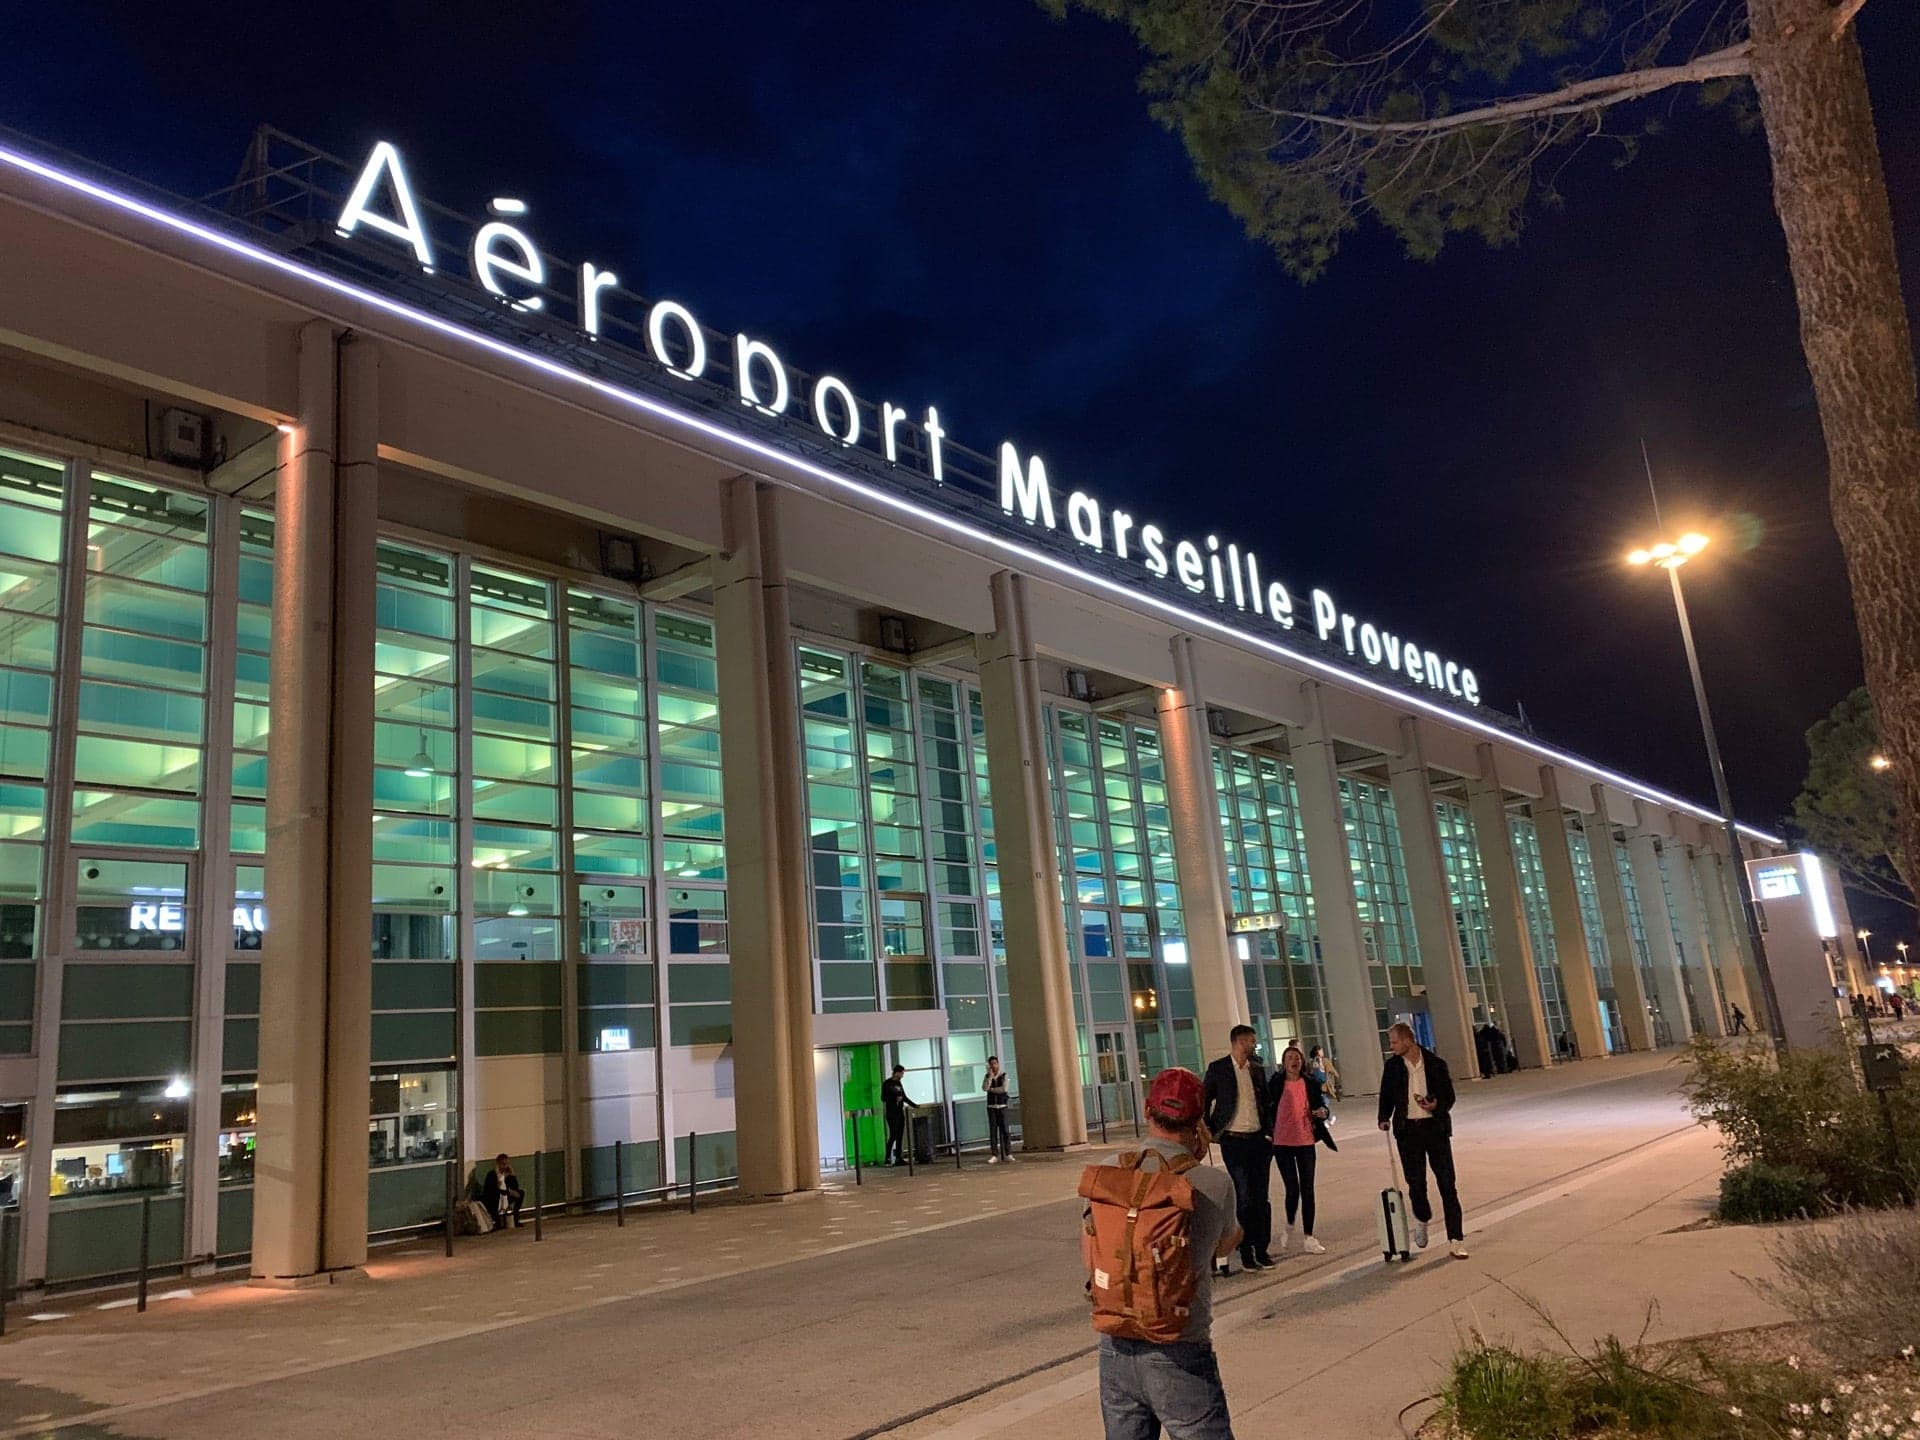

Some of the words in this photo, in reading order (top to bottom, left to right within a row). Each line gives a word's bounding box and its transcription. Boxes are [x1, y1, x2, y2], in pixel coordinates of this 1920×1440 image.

[334, 140, 946, 487] Aéroport
[1000, 441, 1295, 631] Marseille
[1312, 587, 1481, 706] Provence
